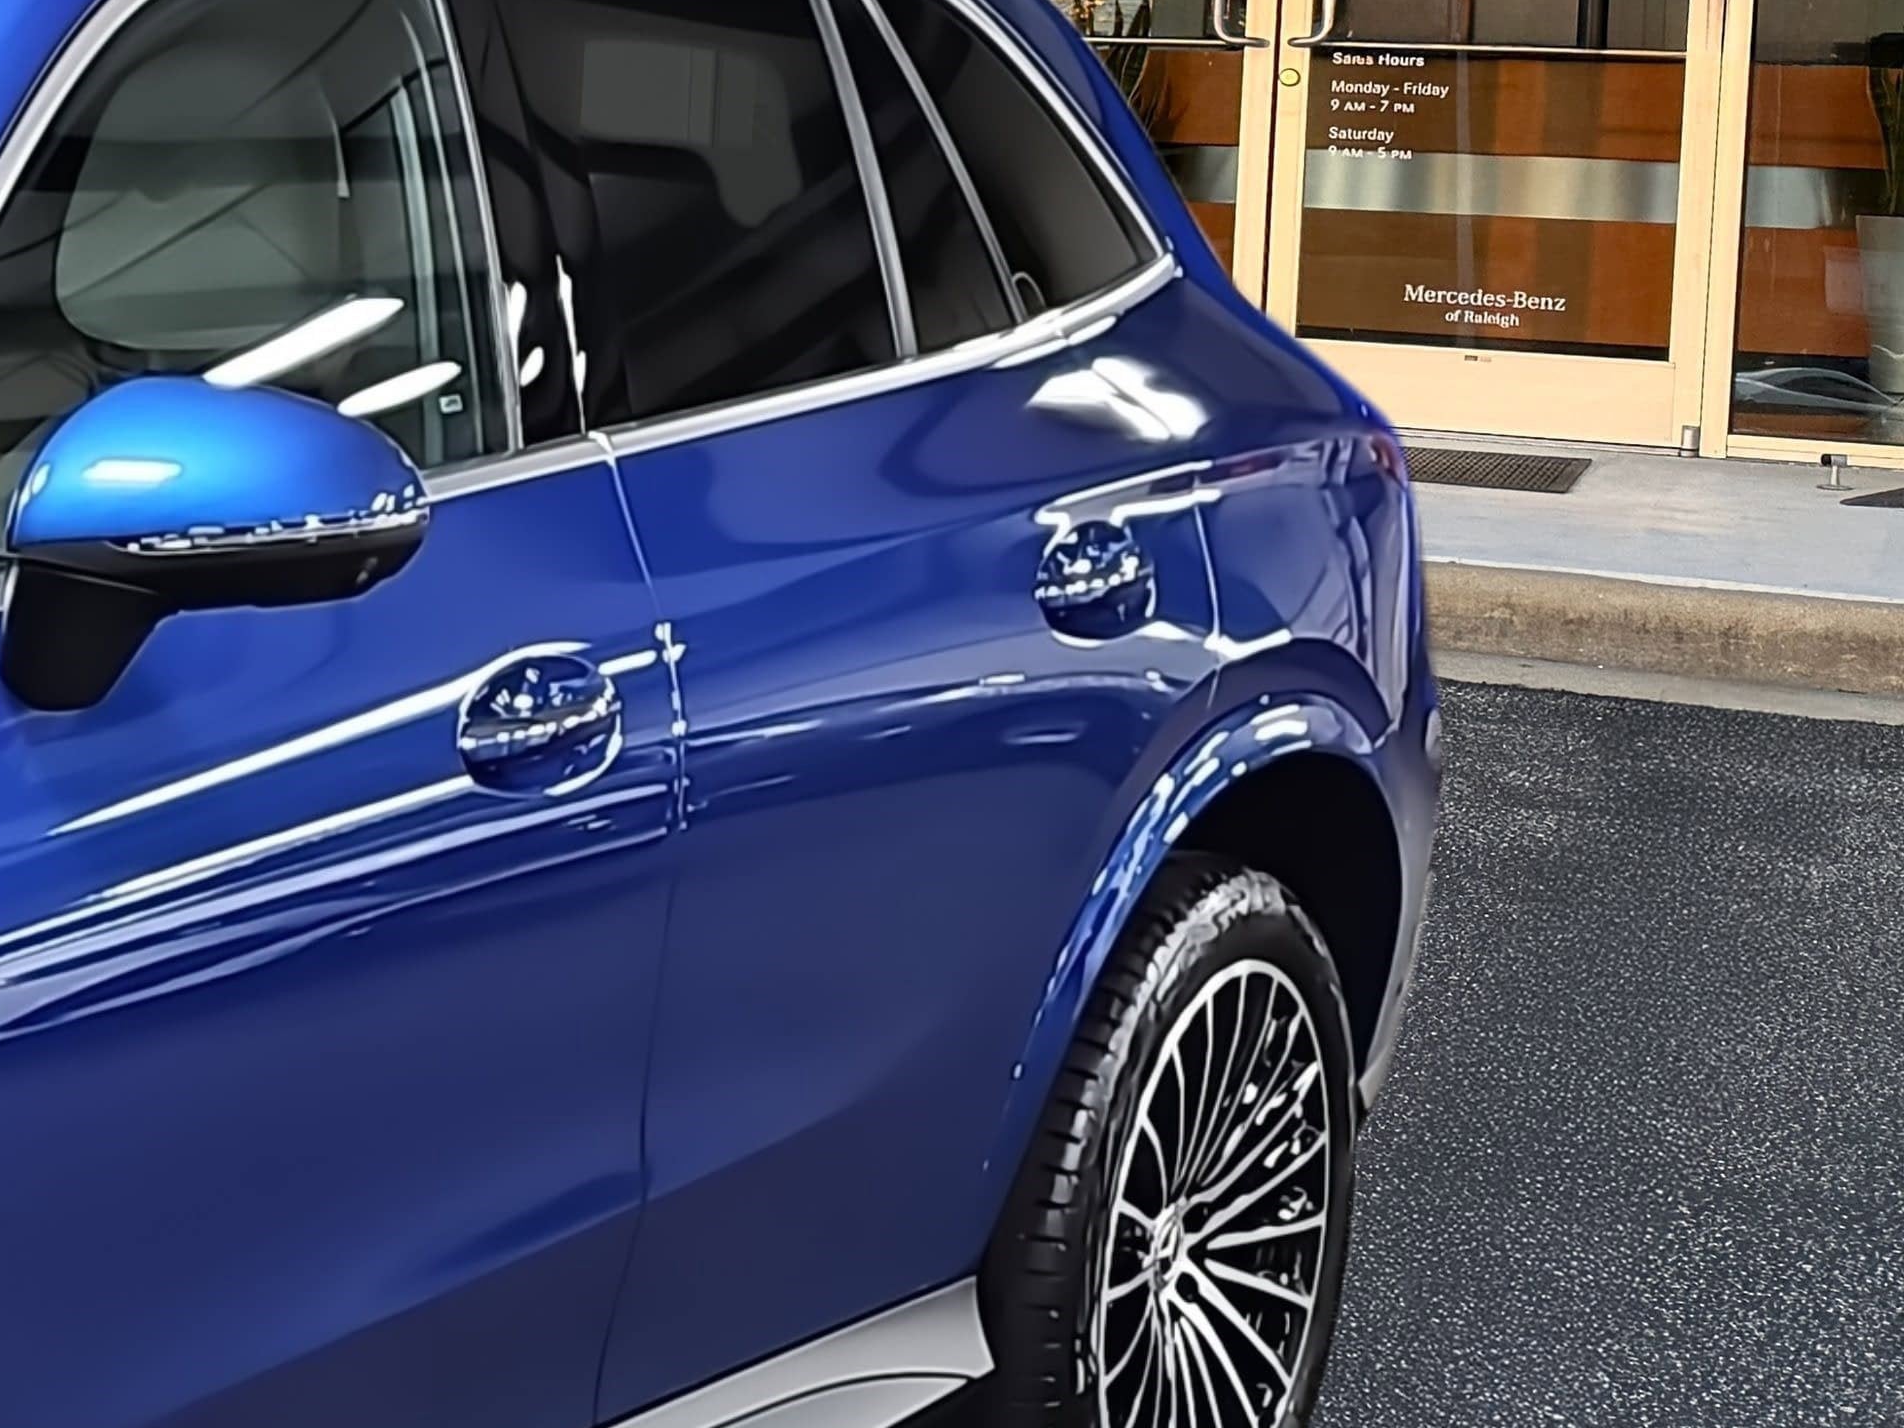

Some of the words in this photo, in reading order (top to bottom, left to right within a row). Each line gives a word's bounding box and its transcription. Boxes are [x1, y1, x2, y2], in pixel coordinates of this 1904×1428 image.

[1378, 53, 1425, 67] Hours
[1331, 80, 1390, 97] Monday
[1403, 82, 1450, 99] Friday
[1330, 98, 1340, 112] 9
[1344, 101, 1366, 112] AM
[1379, 99, 1389, 113] 7
[1393, 103, 1415, 114] PM
[1328, 126, 1394, 144] Saturday
[1328, 145, 1338, 158] 9
[1342, 147, 1364, 159] AM
[1377, 146, 1387, 160] 5
[1391, 149, 1413, 160] PM
[1403, 284, 1567, 312] Mercedes-Benz
[1445, 309, 1462, 323] of
[1464, 310, 1521, 329] Raleigh
